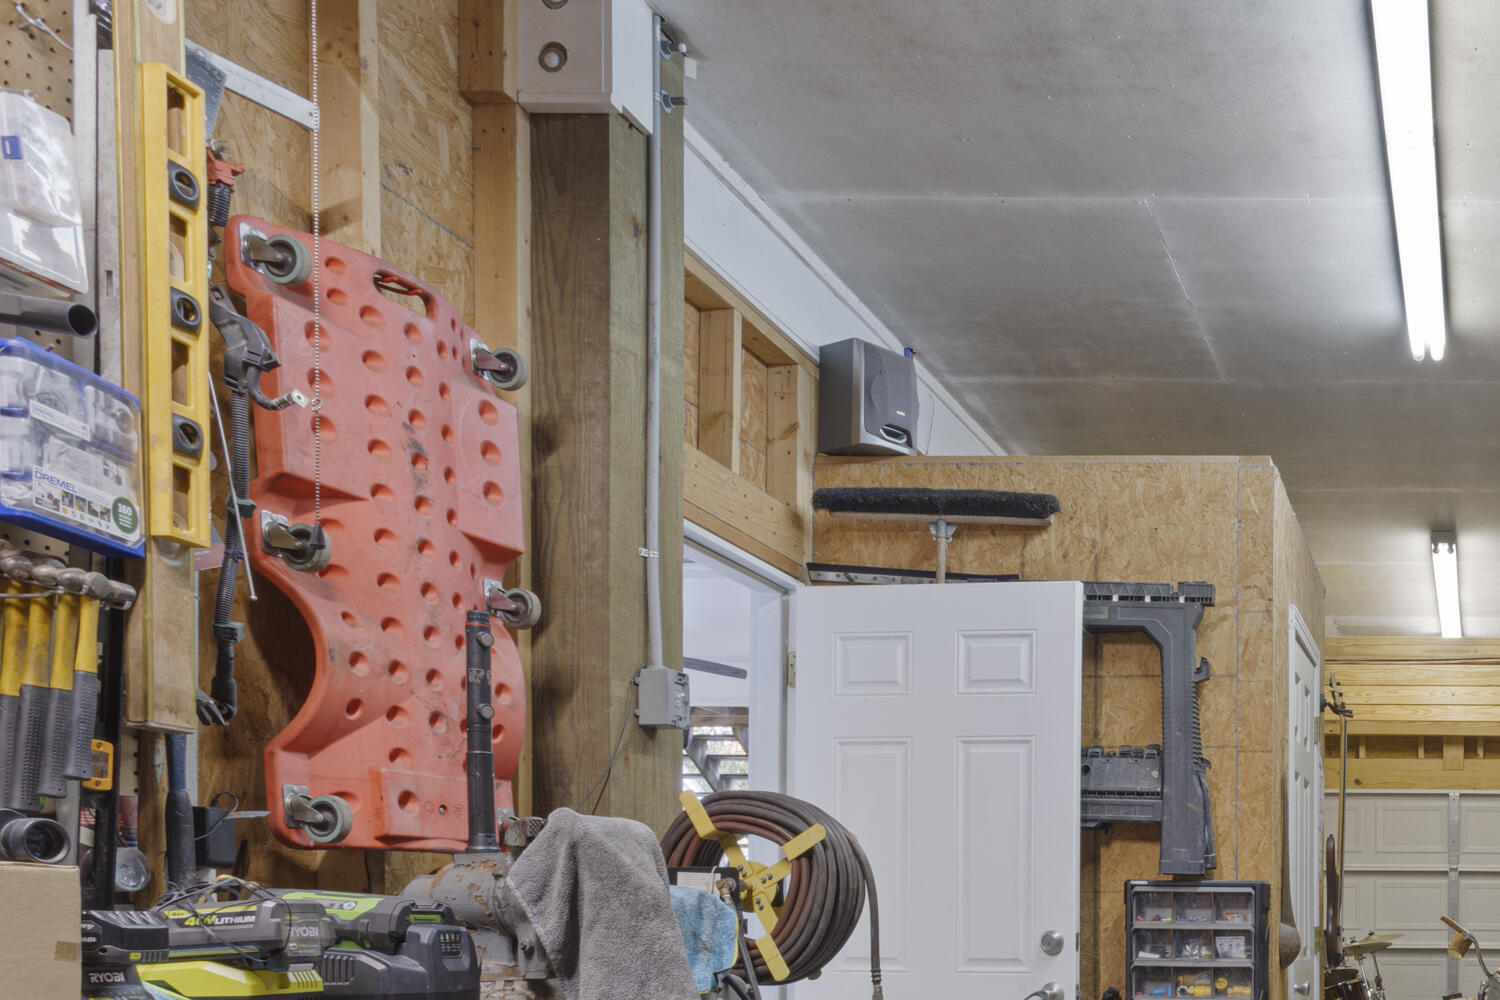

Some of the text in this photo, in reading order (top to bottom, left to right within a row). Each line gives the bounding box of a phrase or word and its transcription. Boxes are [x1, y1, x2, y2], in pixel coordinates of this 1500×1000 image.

[34, 470, 77, 494] DREMEL
[214, 915, 256, 925] LITHIUM
[287, 926, 319, 937] RYOBI
[88, 972, 125, 983] RYOBI
